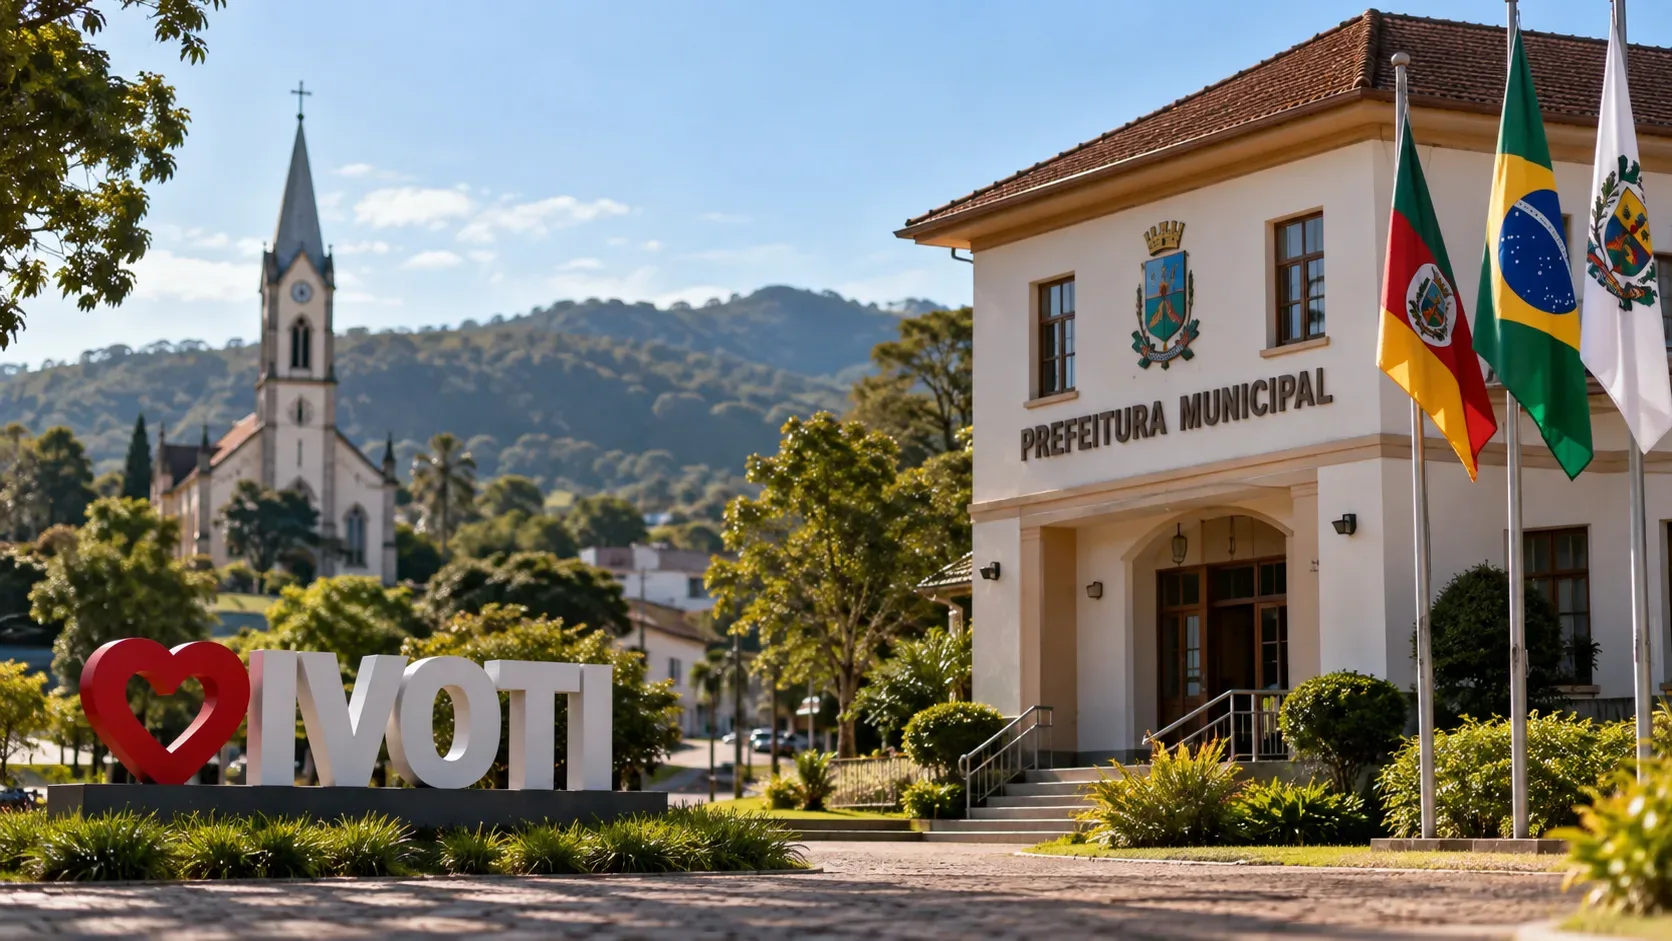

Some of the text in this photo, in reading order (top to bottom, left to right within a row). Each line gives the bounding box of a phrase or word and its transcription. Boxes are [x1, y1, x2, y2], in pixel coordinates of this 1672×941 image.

[1021, 367, 1333, 461] PREFEITURA MUNICIPAL
[246, 649, 613, 790] IVOTI
